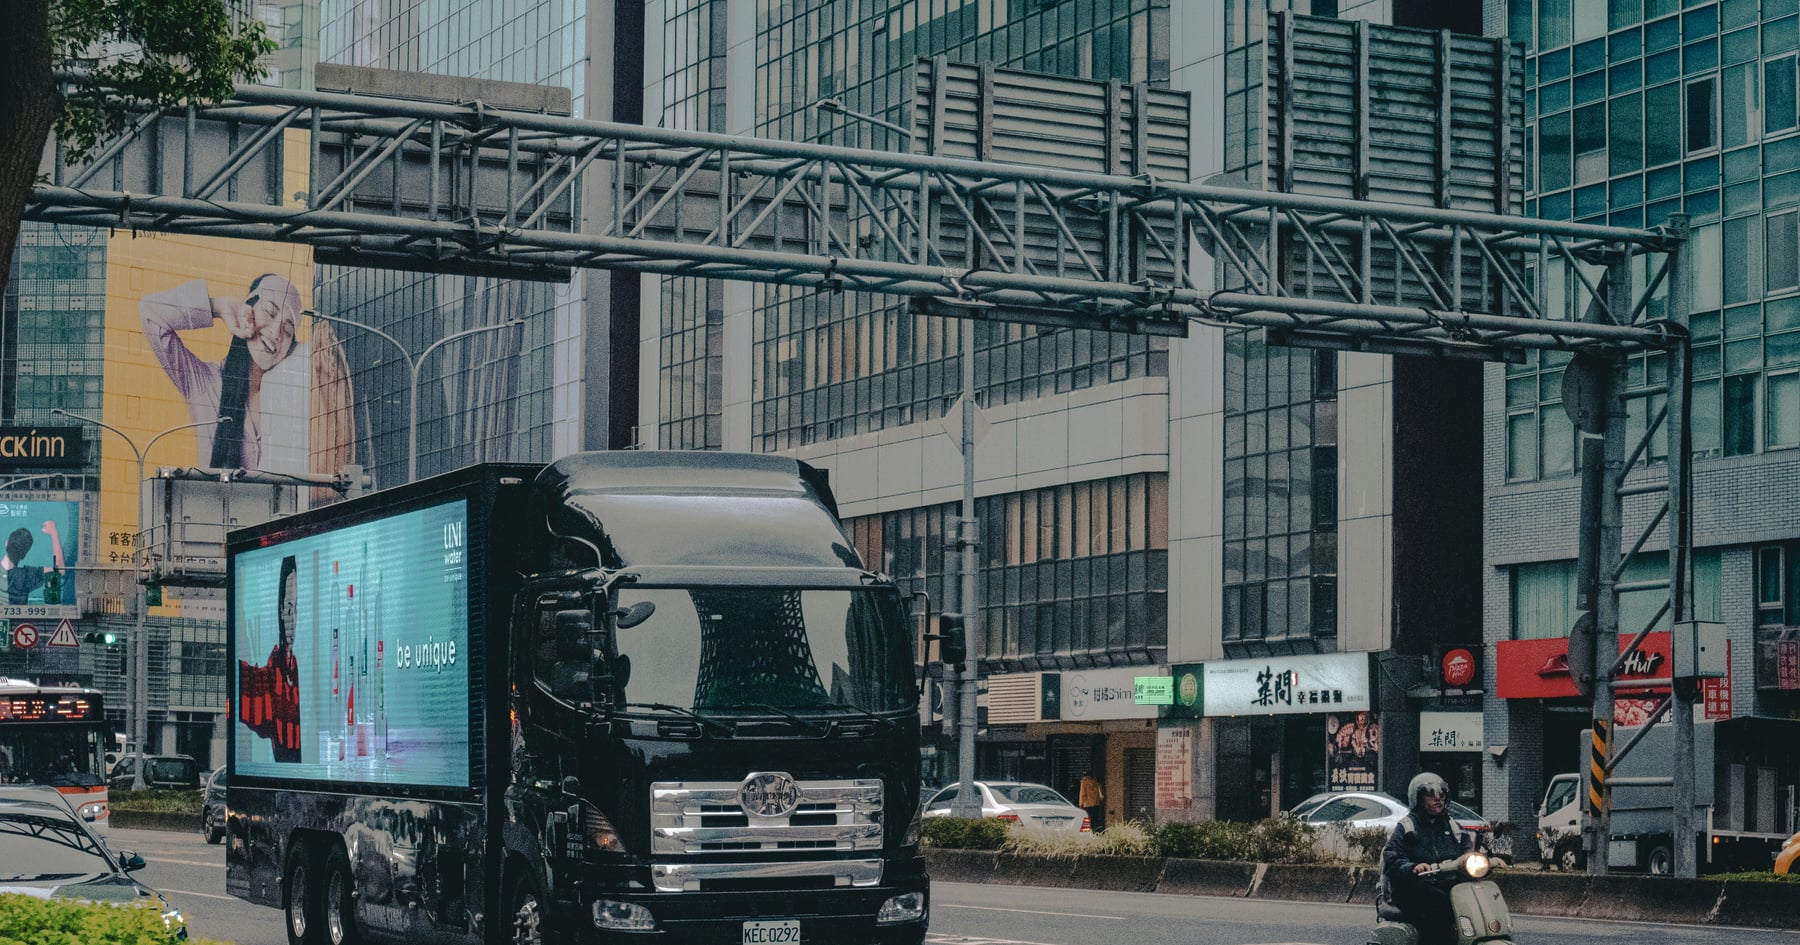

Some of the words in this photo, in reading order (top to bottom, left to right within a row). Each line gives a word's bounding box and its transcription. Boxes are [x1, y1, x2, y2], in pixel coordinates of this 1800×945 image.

[0, 435, 28, 458] CK
[444, 521, 462, 549] UNI
[444, 550, 462, 565] water
[397, 638, 412, 669] be
[415, 634, 457, 674] unique
[1624, 650, 1660, 675] Hut
[1448, 662, 1468, 676] Pizza
[1452, 669, 1466, 679] Hut
